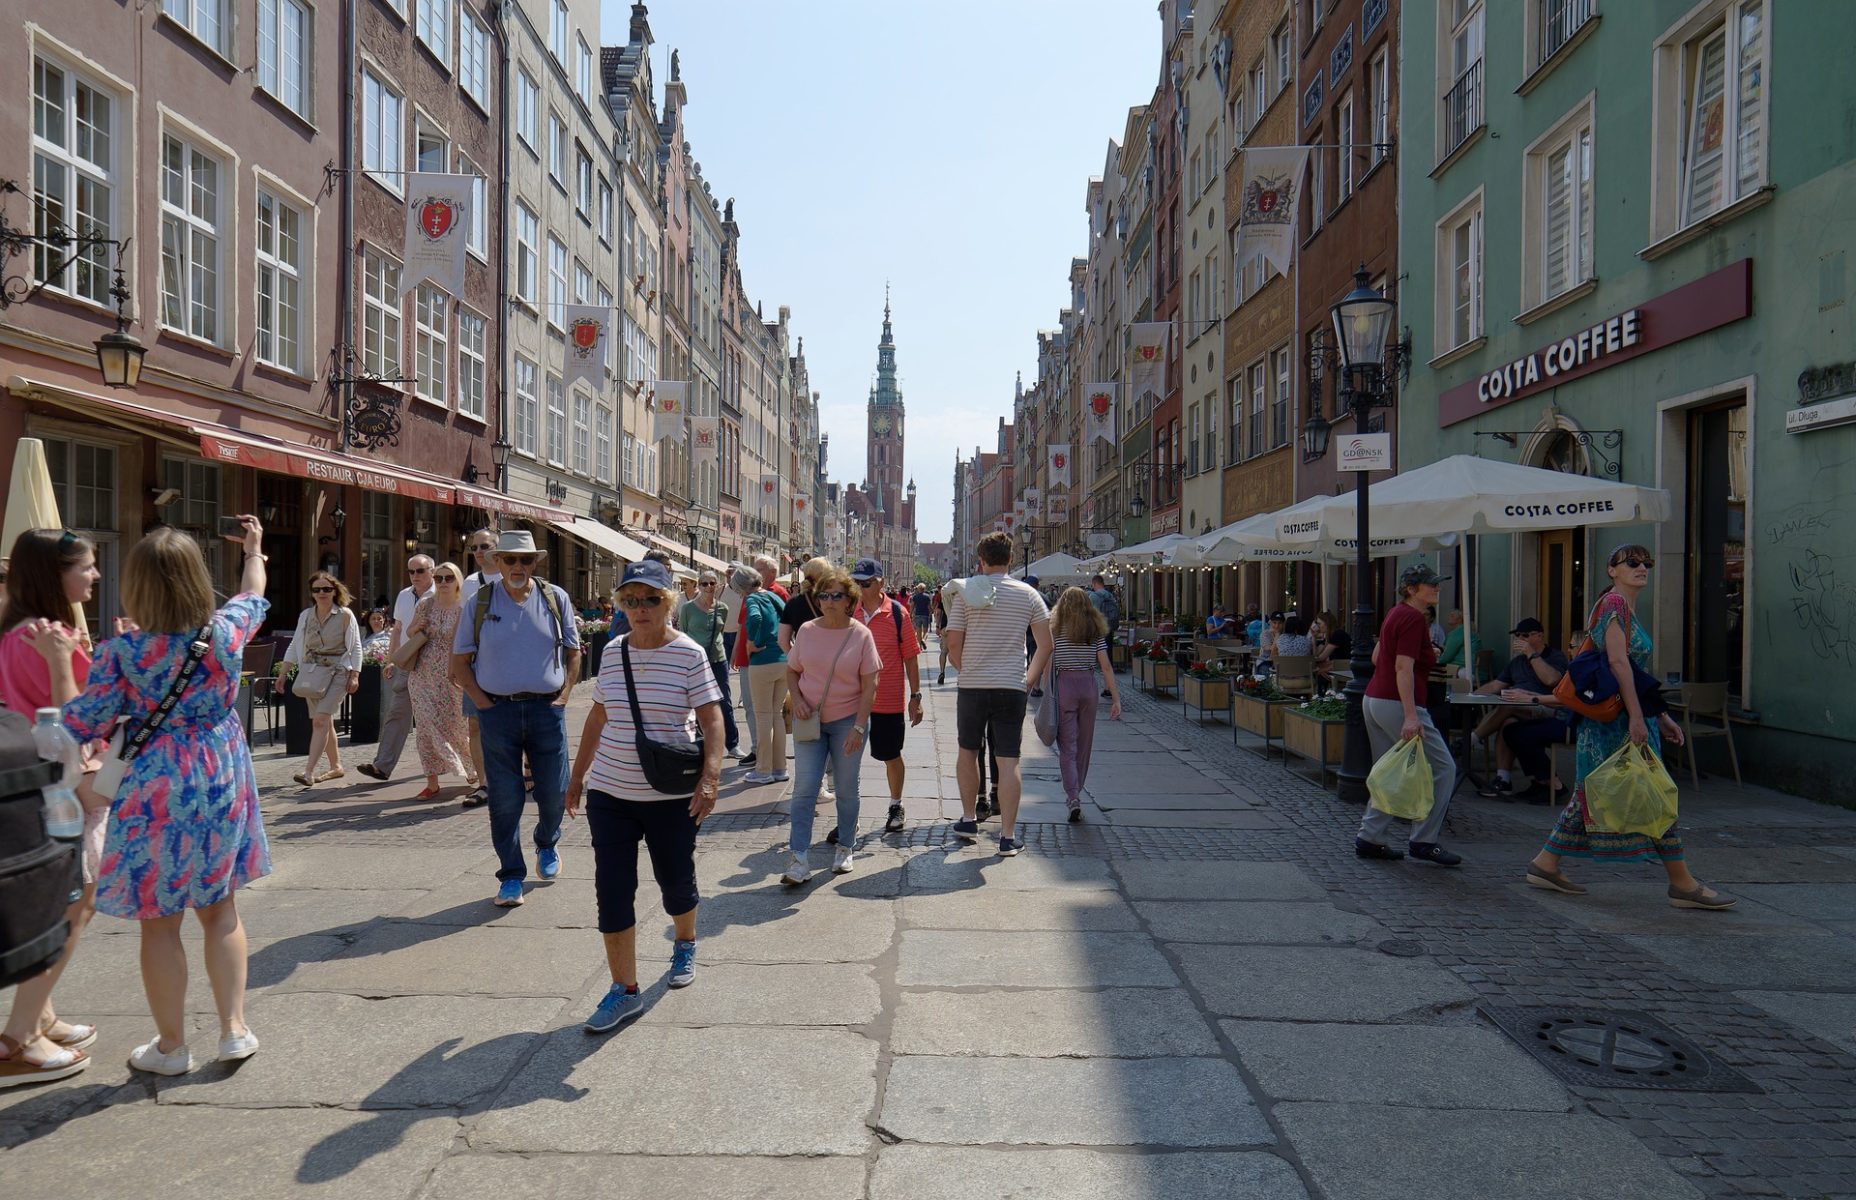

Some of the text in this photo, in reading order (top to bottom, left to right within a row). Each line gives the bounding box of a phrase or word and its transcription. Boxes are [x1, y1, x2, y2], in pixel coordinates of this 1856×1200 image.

[1478, 310, 1639, 402] COSTA COFFEE
[375, 477, 397, 491] EURO
[1504, 500, 1614, 517] COSTA COFFEE
[1283, 520, 1319, 534] COSTA COFFEE
[1334, 538, 1406, 548] COST COFFEE
